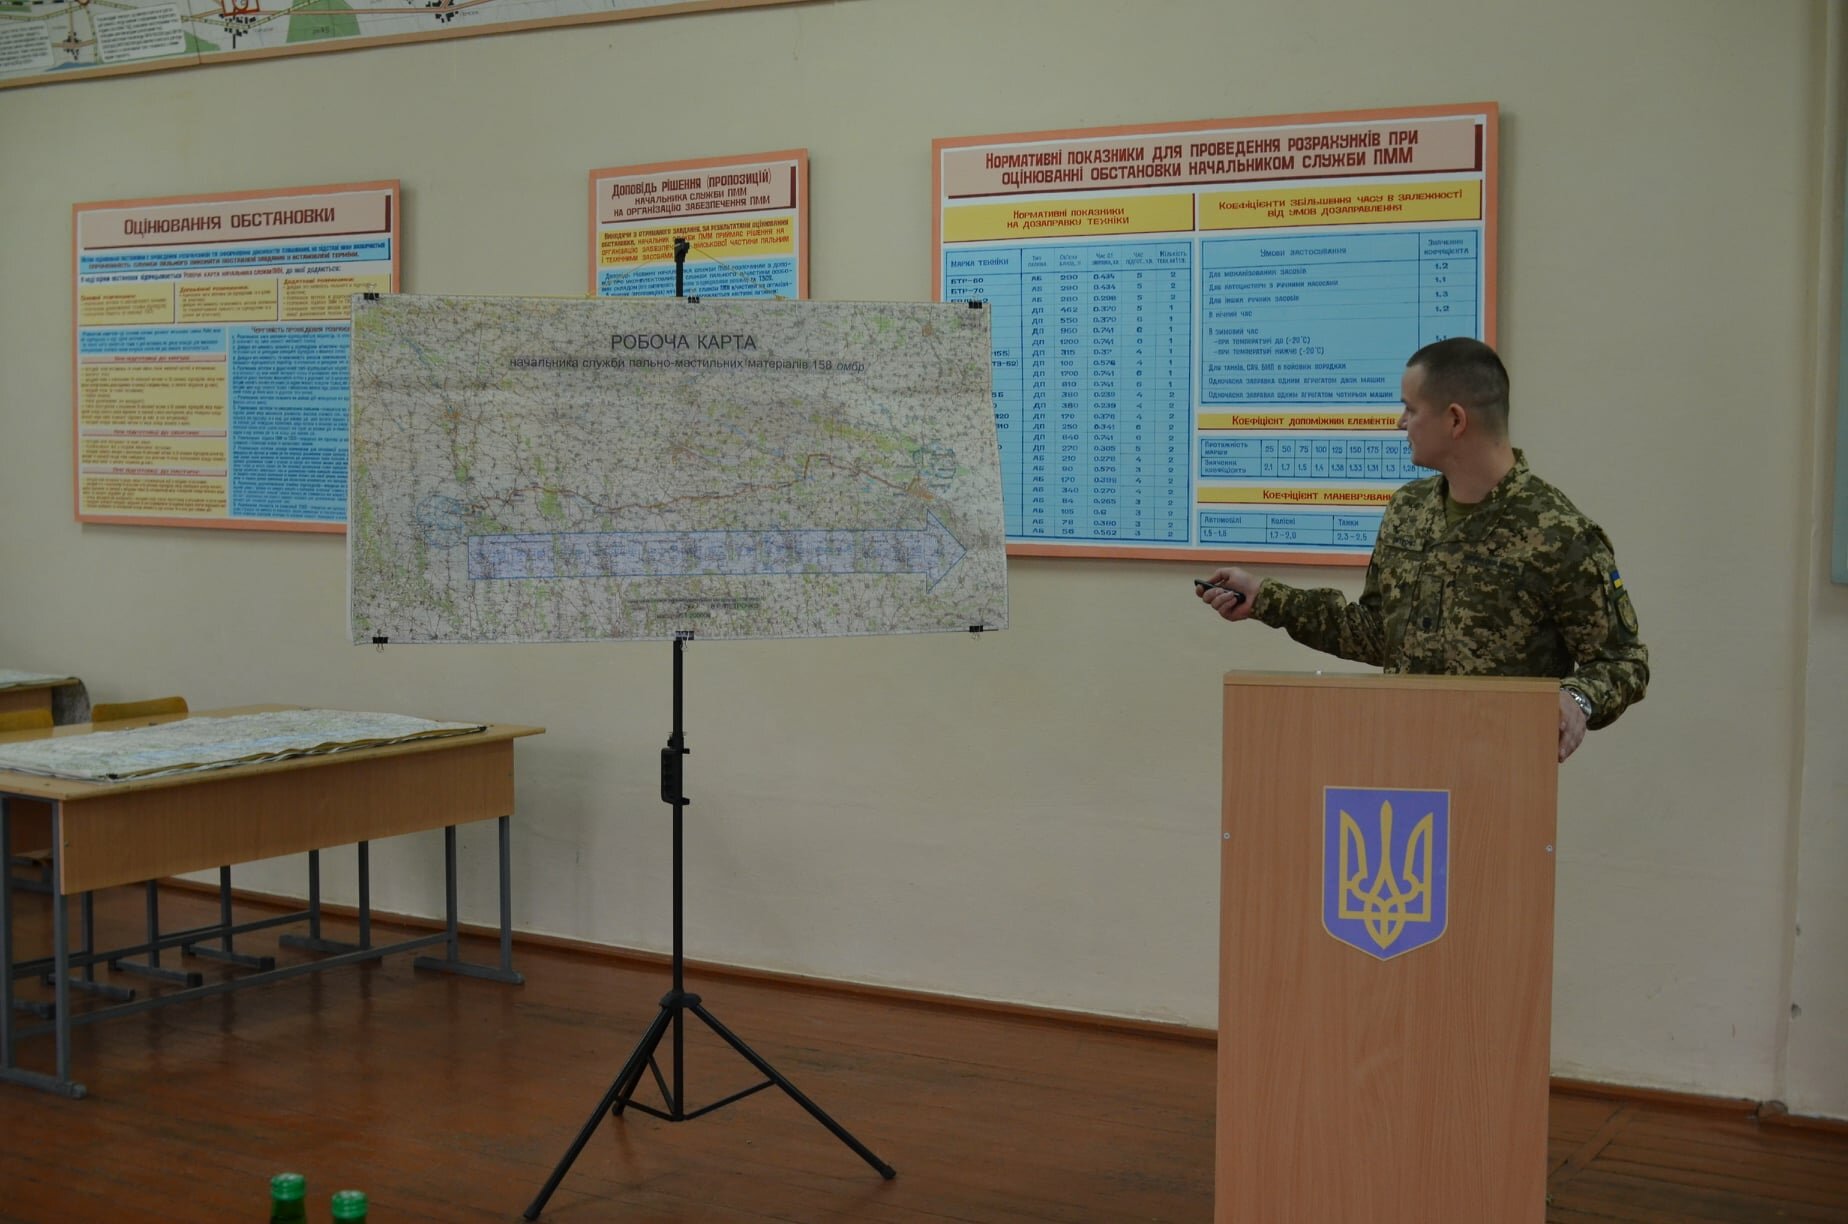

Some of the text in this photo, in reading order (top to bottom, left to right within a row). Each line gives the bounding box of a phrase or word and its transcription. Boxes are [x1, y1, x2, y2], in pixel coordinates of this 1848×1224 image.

[986, 130, 1418, 169] НОРМАТИВНІ ПОКАЗНИКИ ДЛЯ ПРОВЕДЕННЯ РОЗРАХУНКІВ ПРИ
[1002, 147, 1413, 188] ОЦІНЮВАННІ ОБСТАНОВКИ НАЧАЛЬНИКОМ СЛУЖБИ ПММ
[612, 168, 772, 200] ДОПОВІДЬ РІШЕННЯ (ПРОПОЗИЦІЙ)
[634, 187, 747, 206] НАЧАЛЬНИКА СЛУЖБИ ПММ
[1218, 200, 1286, 211] КОЕФІЦІЄНТИ
[1290, 196, 1352, 208] ЗБІЛЬШЕННЯ
[1356, 194, 1384, 204] ЧАСУ
[1398, 188, 1463, 200] ЗАЛЕЖНОСТІ
[614, 195, 770, 218] НА ОРГАНІЗАЦІЮ ЗАБЕЗПЕЧЕННЯ ПММ
[1013, 208, 1124, 219] НОРМАТИВНІ ПОКАЗНИКИ
[1268, 204, 1402, 218] ВІД УМОВ ДОЗАПРАВЛЕННЯ
[124, 208, 335, 239] ОЦІНЮВАННЯ ОБСТАНОВКИ
[1007, 216, 1130, 230] НА ДОЗАПРАВКУ ТЕХНІКИ
[611, 334, 756, 350] РОБОЧА КАРТА
[510, 358, 865, 374] начальника служби пально-мастильних матеріалів 158 омбр
[1232, 414, 1283, 426] КОЕФІЦІЄНТ
[1348, 416, 1395, 426] ЕЛЕМЕНТІВ
[1300, 446, 1309, 454] 75
[1316, 446, 1327, 454] 100
[1263, 490, 1392, 501] КОЕФІЦІЄНТ МАНЕВРУВАН
